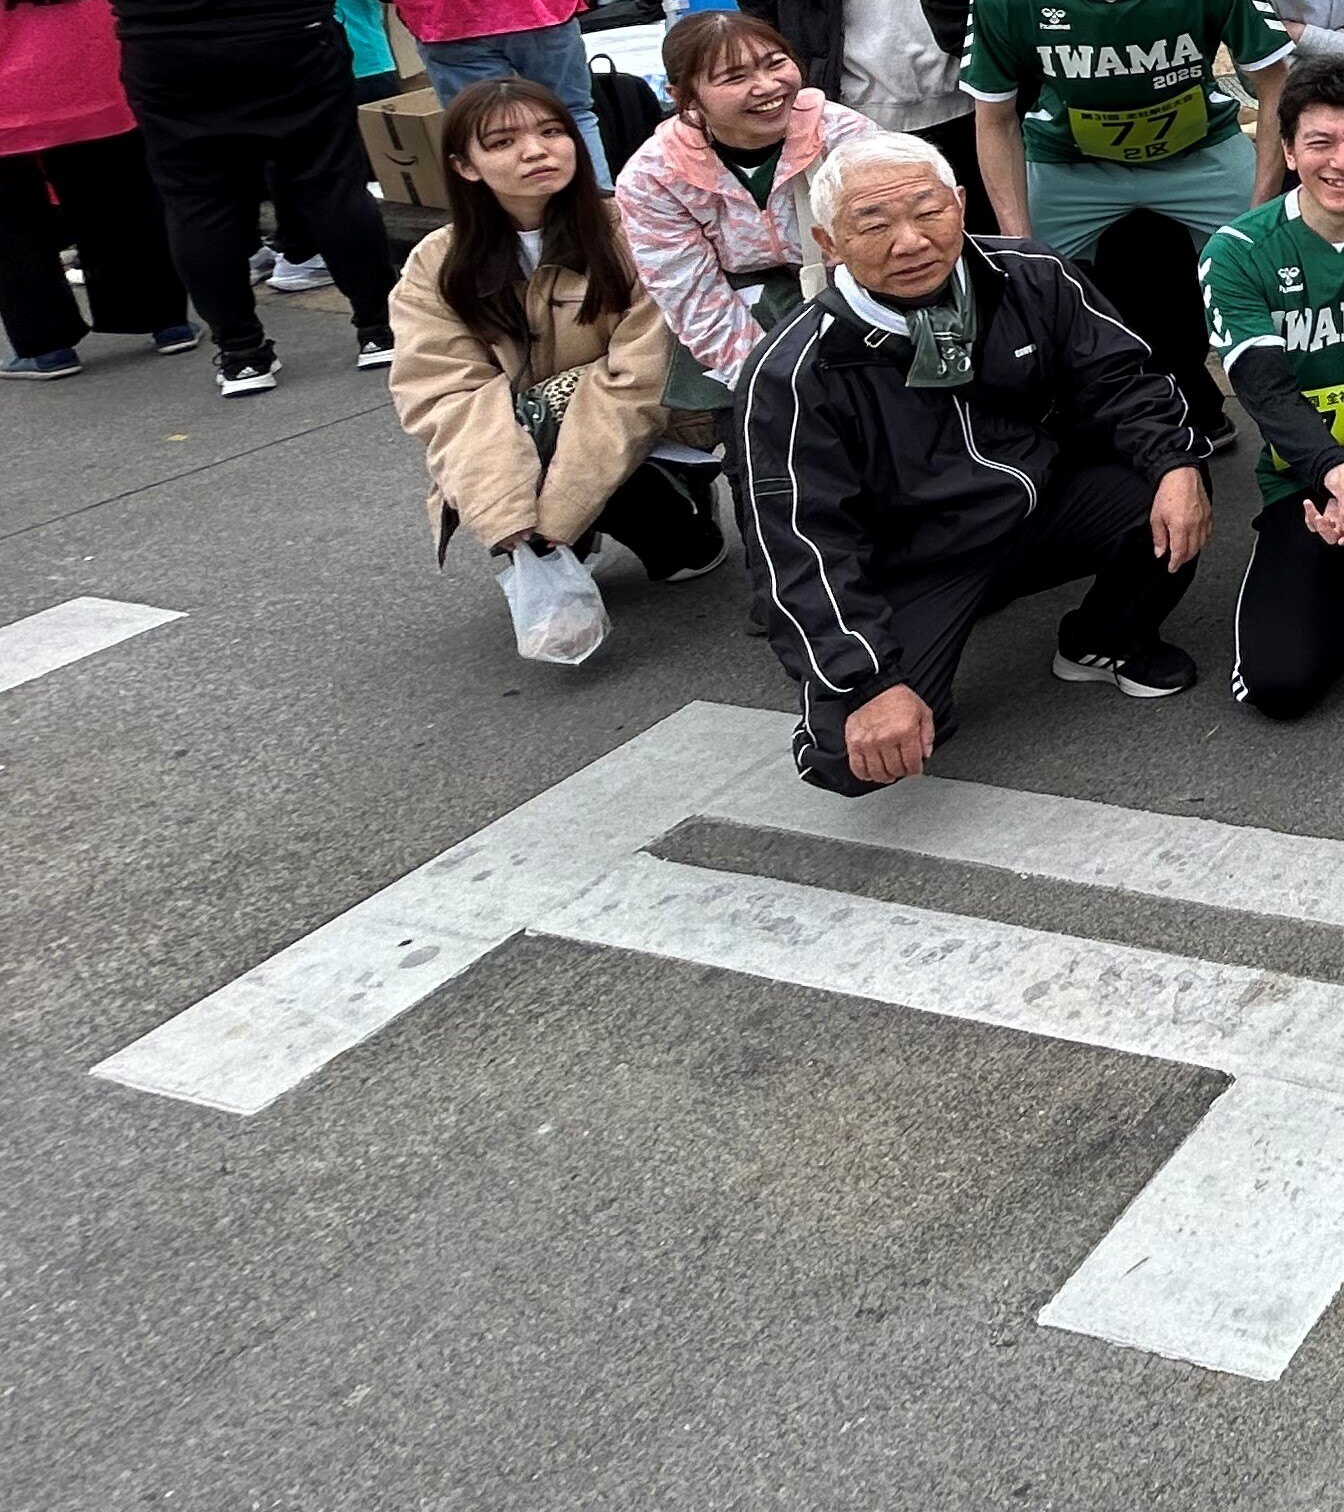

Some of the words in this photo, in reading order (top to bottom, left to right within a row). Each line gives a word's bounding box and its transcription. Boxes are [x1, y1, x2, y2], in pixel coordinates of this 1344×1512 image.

[1036, 33, 1203, 79] IWAMA
[1152, 64, 1203, 90] 2025
[1101, 110, 1178, 147] 77
[1123, 141, 1170, 161] 2区
